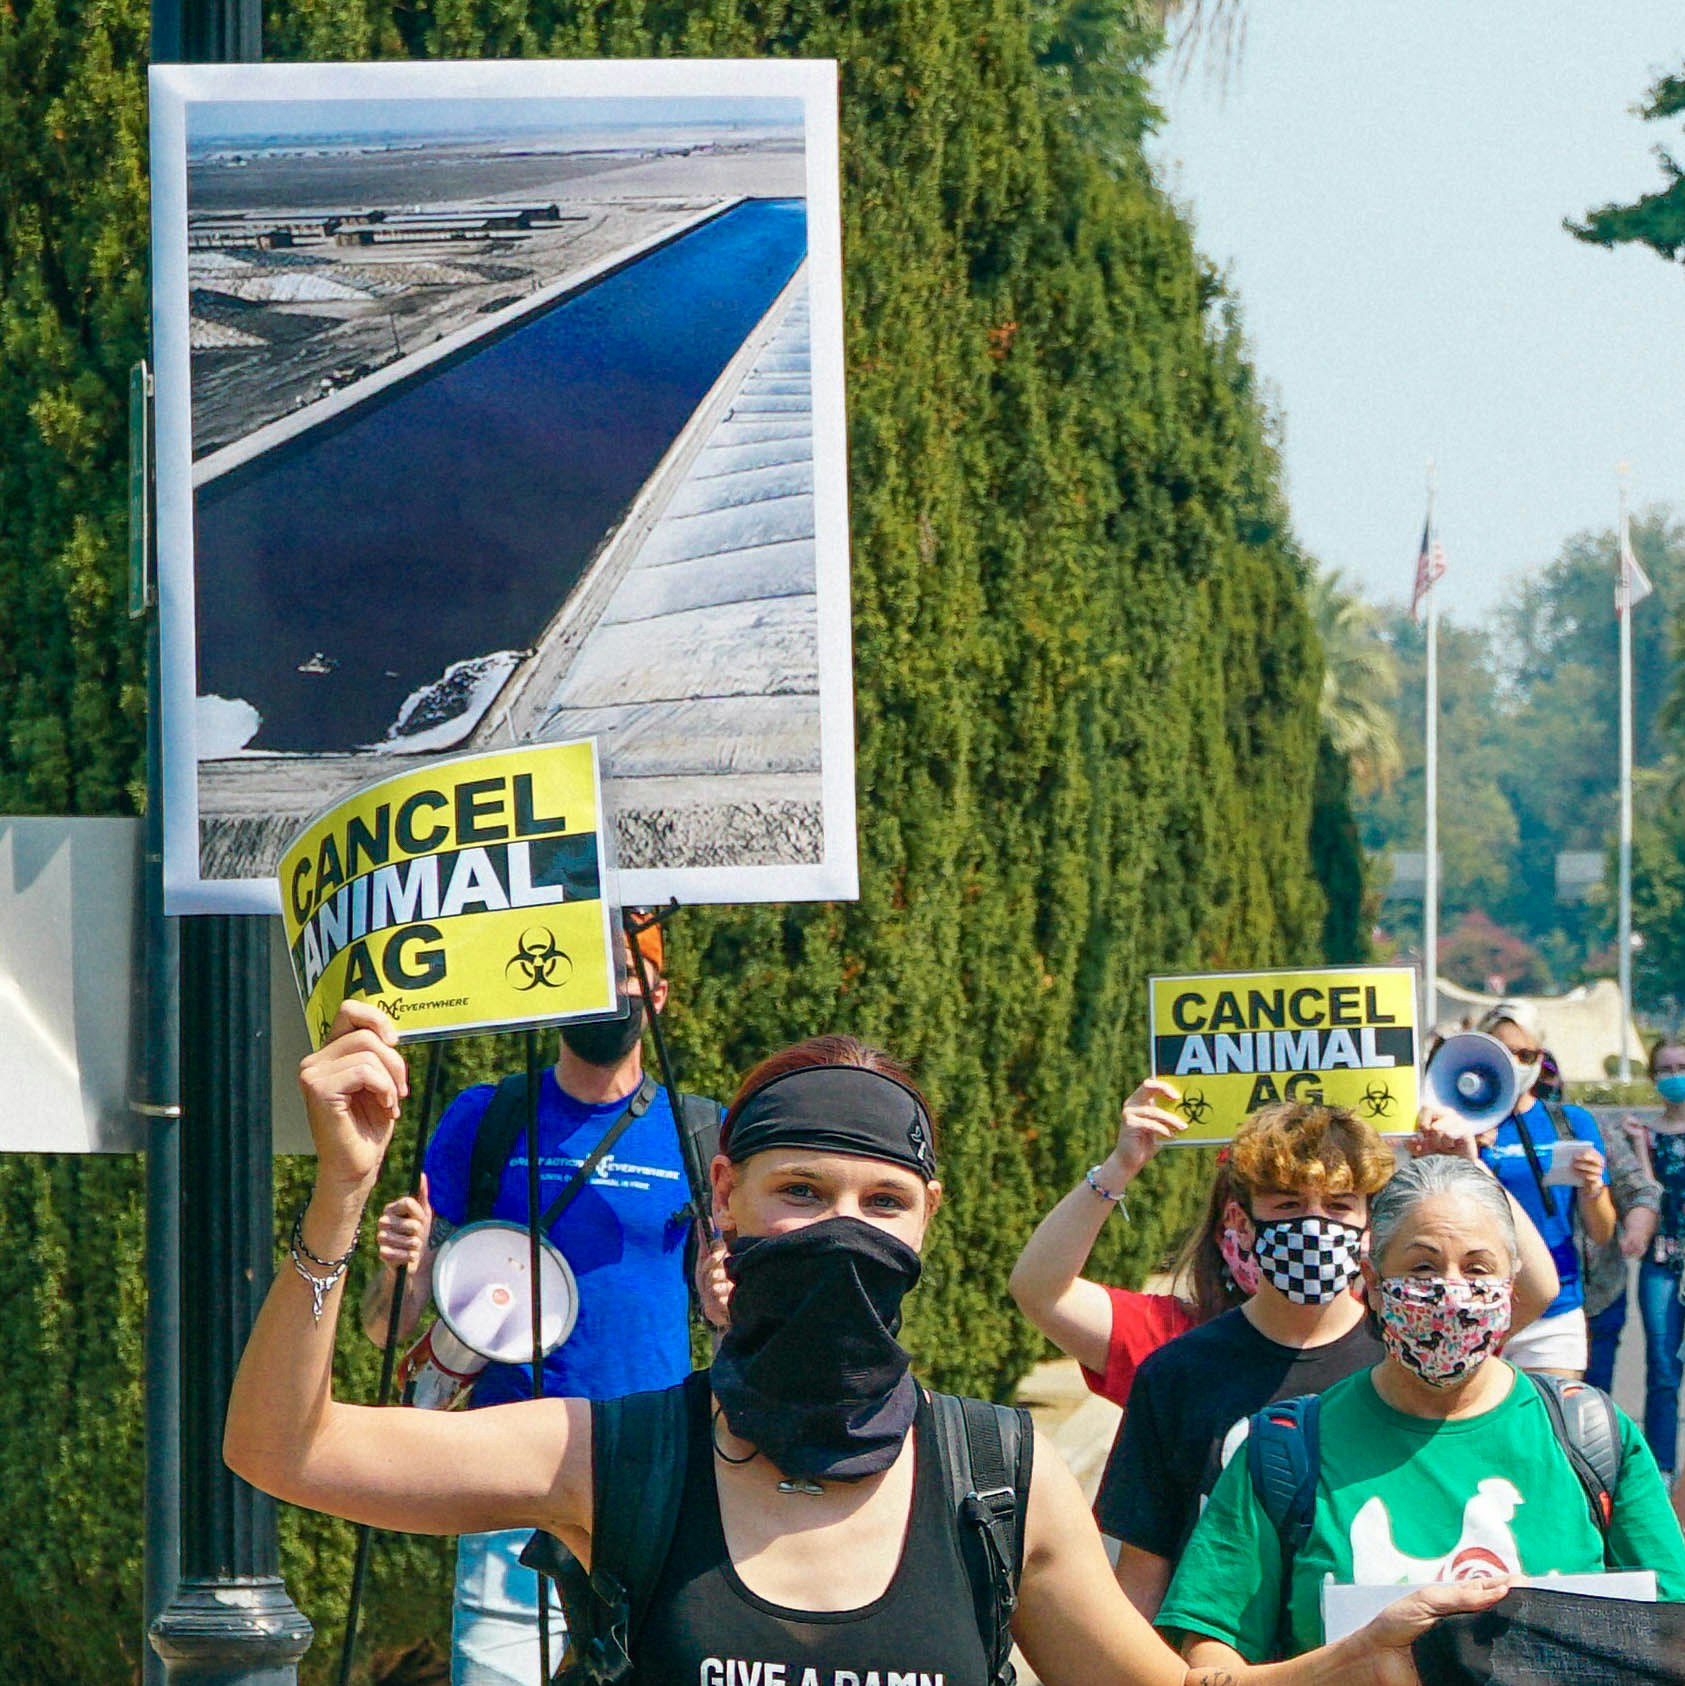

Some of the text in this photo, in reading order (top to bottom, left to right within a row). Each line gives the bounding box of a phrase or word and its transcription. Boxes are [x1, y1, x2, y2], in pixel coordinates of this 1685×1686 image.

[292, 773, 566, 926] CANCEL
[303, 841, 564, 997] ANIMAL
[343, 924, 447, 1000] AG
[400, 997, 470, 1013] EVERYWHERE
[1172, 986, 1396, 1031] CANCEL
[1175, 1027, 1395, 1075] ANIMAL
